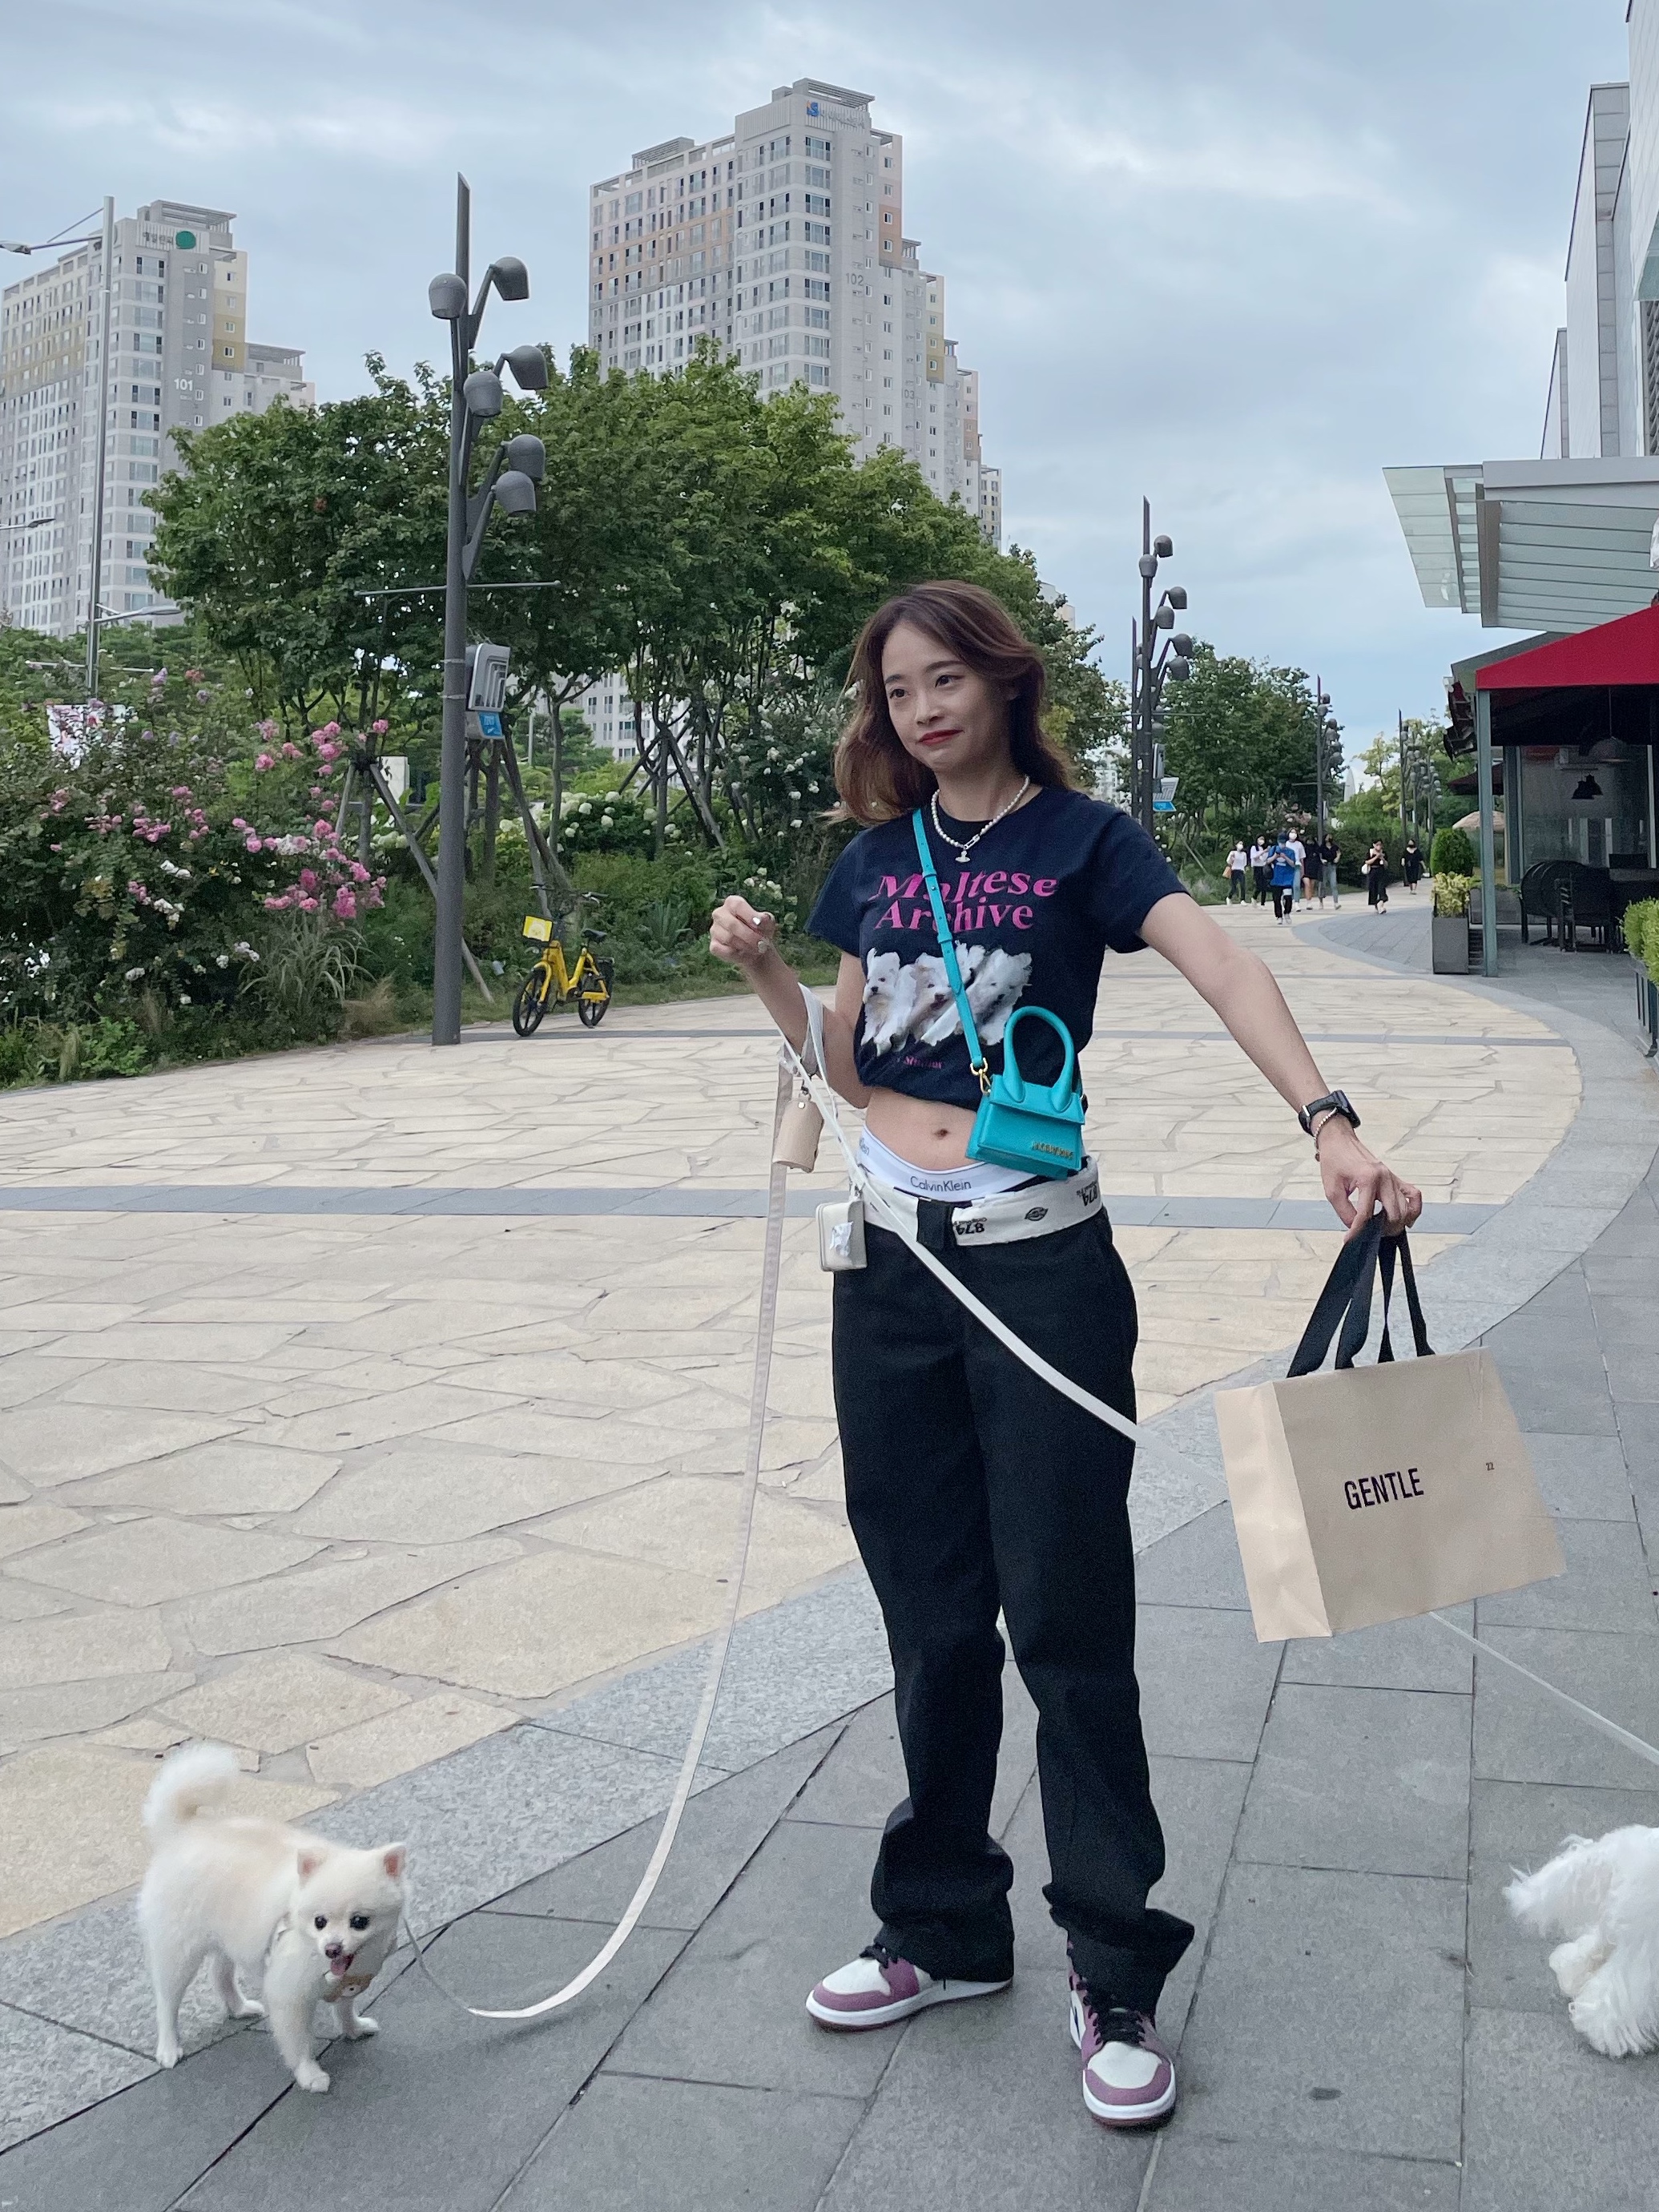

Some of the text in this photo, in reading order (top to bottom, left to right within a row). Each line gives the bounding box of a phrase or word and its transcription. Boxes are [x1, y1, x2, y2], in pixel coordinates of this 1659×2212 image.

[846, 272, 864, 286] 102
[174, 377, 194, 392] 101
[874, 896, 1035, 933] Arhive
[1344, 1468, 1424, 1510] GENTLE
